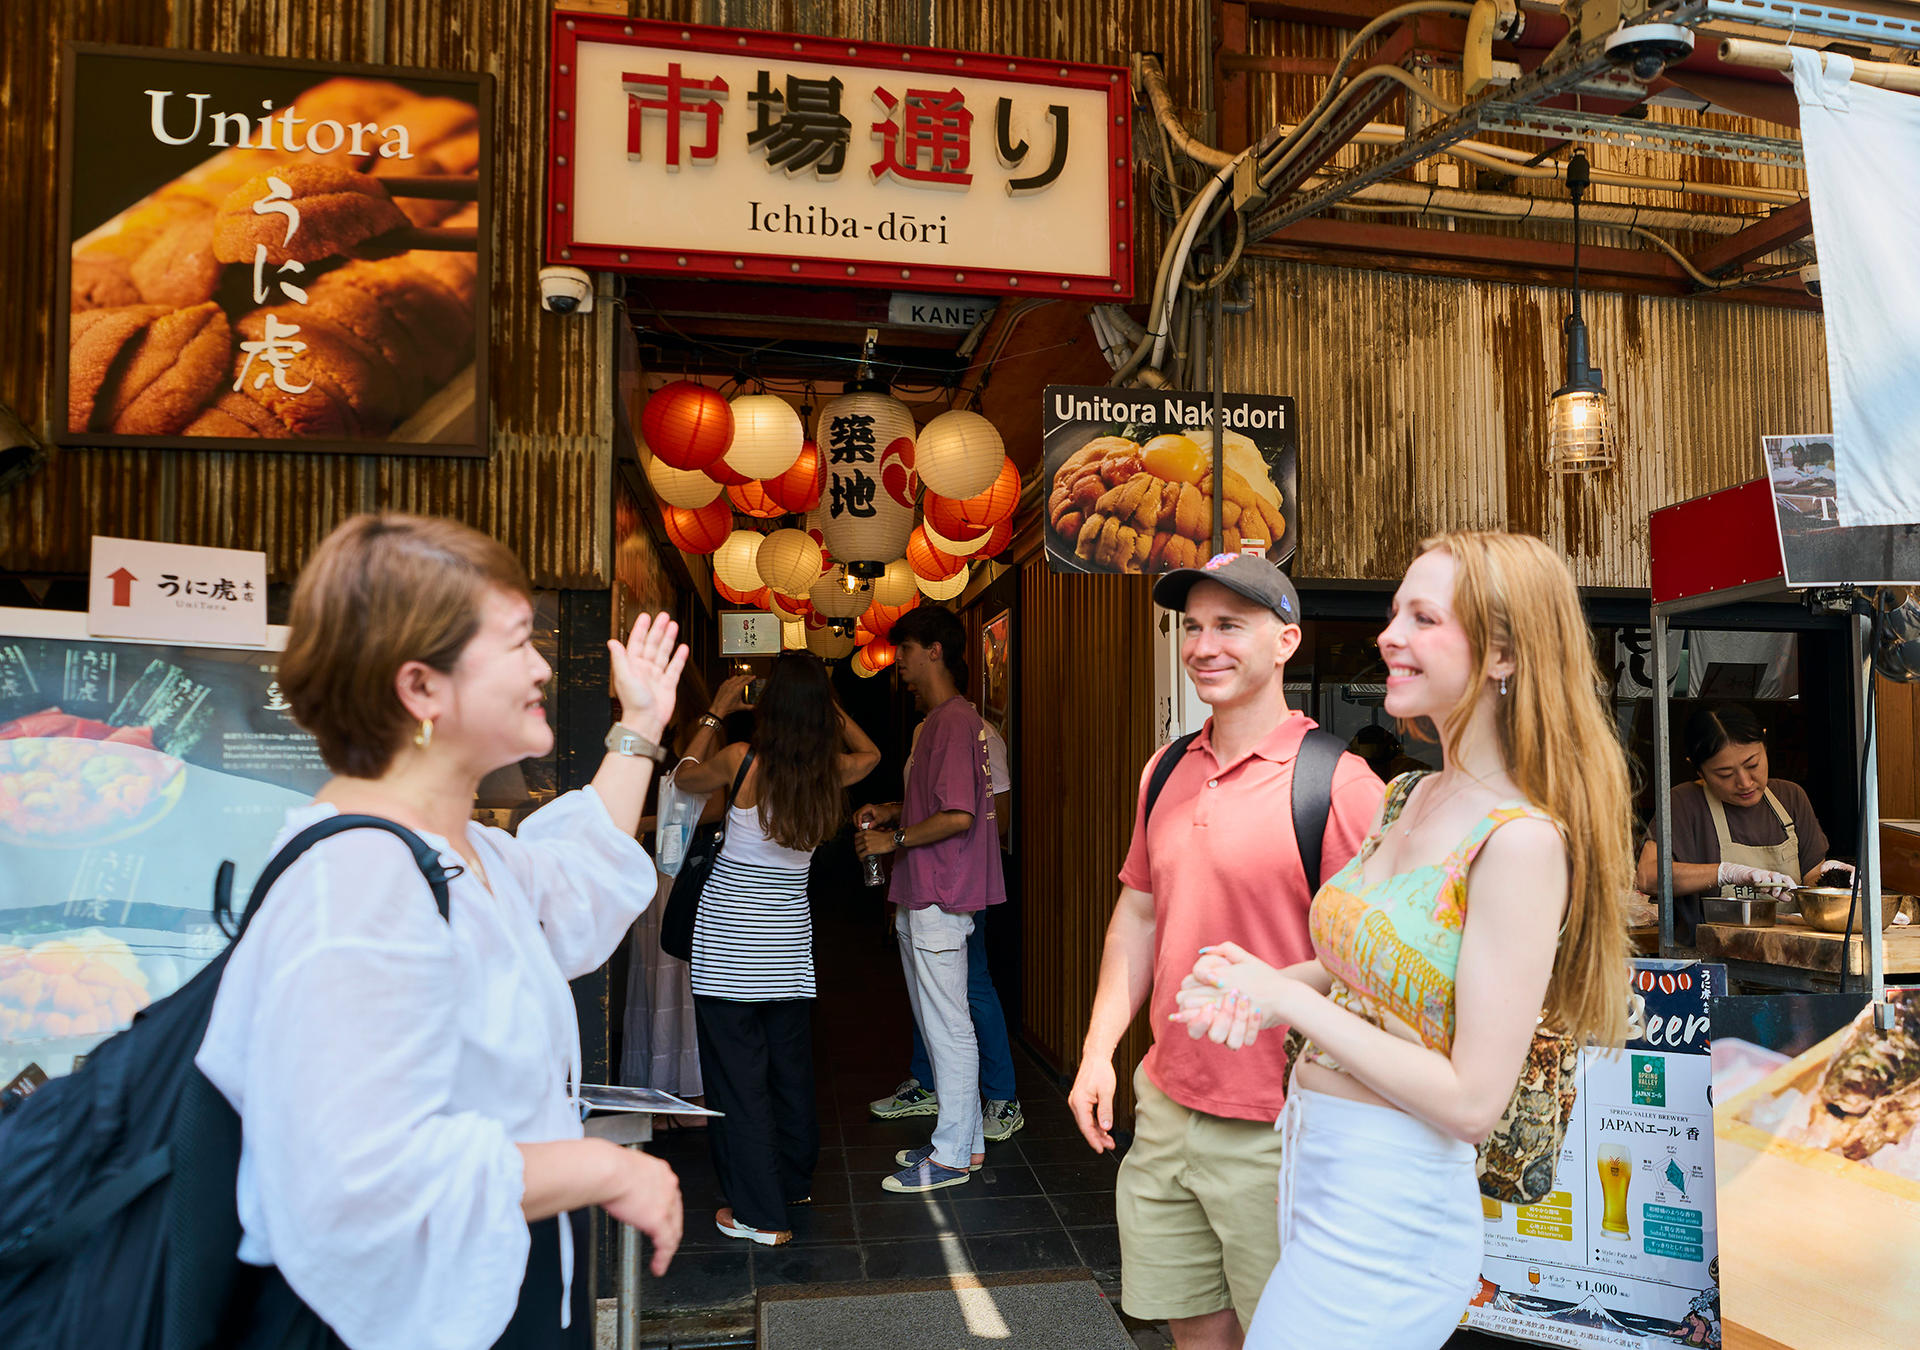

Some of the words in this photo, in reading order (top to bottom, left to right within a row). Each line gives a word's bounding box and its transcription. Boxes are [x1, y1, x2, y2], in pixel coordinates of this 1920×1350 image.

[144, 90, 414, 161] Unitora
[621, 62, 1069, 197] 市場通り
[747, 202, 949, 245] Ichiba-dōri
[233, 176, 314, 395] うに虎
[1055, 394, 1156, 424] Unitora
[1165, 400, 1285, 429] Nakadori
[829, 413, 877, 519] 築地
[158, 574, 237, 601] うに虎
[1600, 1118, 1681, 1137] JAPANエール
[1686, 1127, 1700, 1140] 香
[1634, 1111, 1656, 1119] VALLEY
[1658, 1114, 1689, 1122] BREWERY
[1576, 1281, 1617, 1296] ¥1,000
